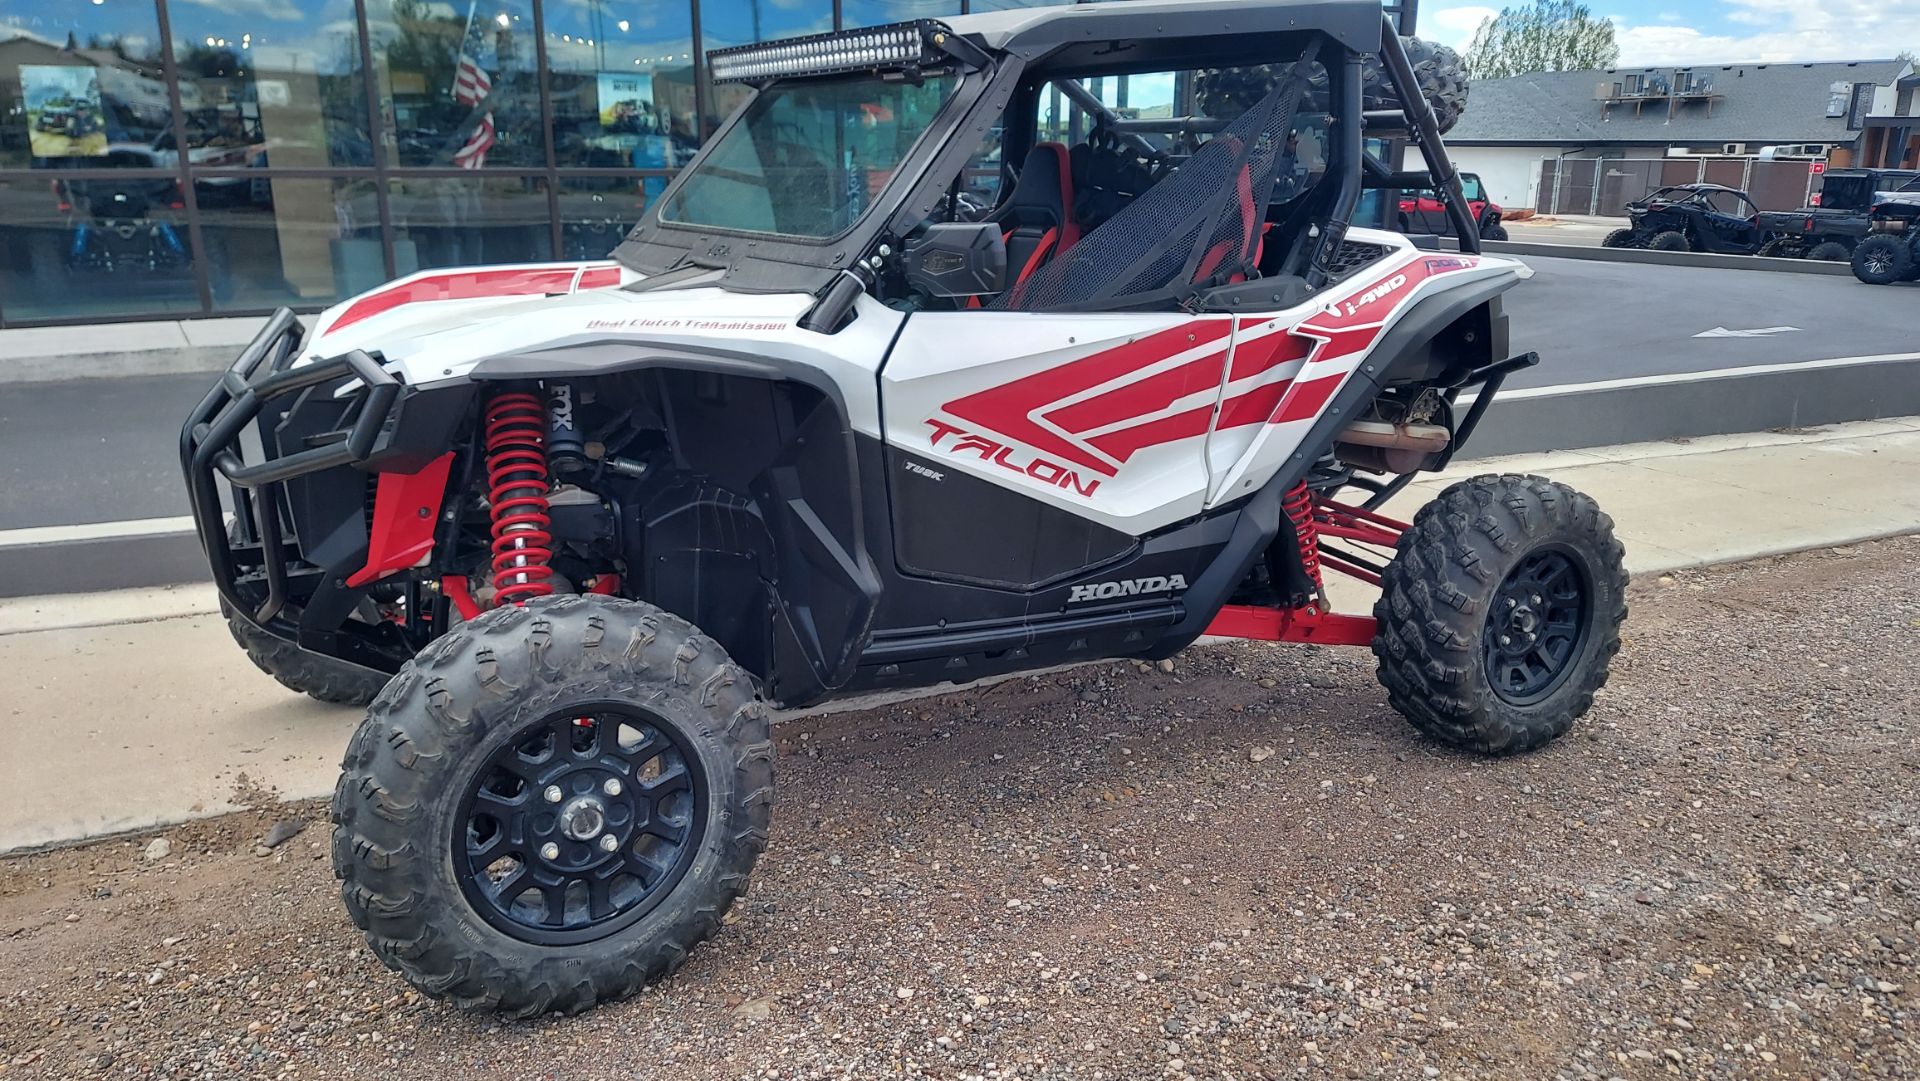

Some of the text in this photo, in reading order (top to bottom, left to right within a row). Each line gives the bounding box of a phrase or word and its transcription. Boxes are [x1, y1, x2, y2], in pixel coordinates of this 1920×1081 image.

[1345, 274, 1407, 316] i-4WD
[630, 318, 681, 328] Clutch
[685, 319, 788, 331] Transmission
[550, 385, 573, 431] FOX
[905, 462, 944, 482] TUSK
[923, 418, 1102, 498] TALON
[1067, 574, 1188, 603] HONDA
